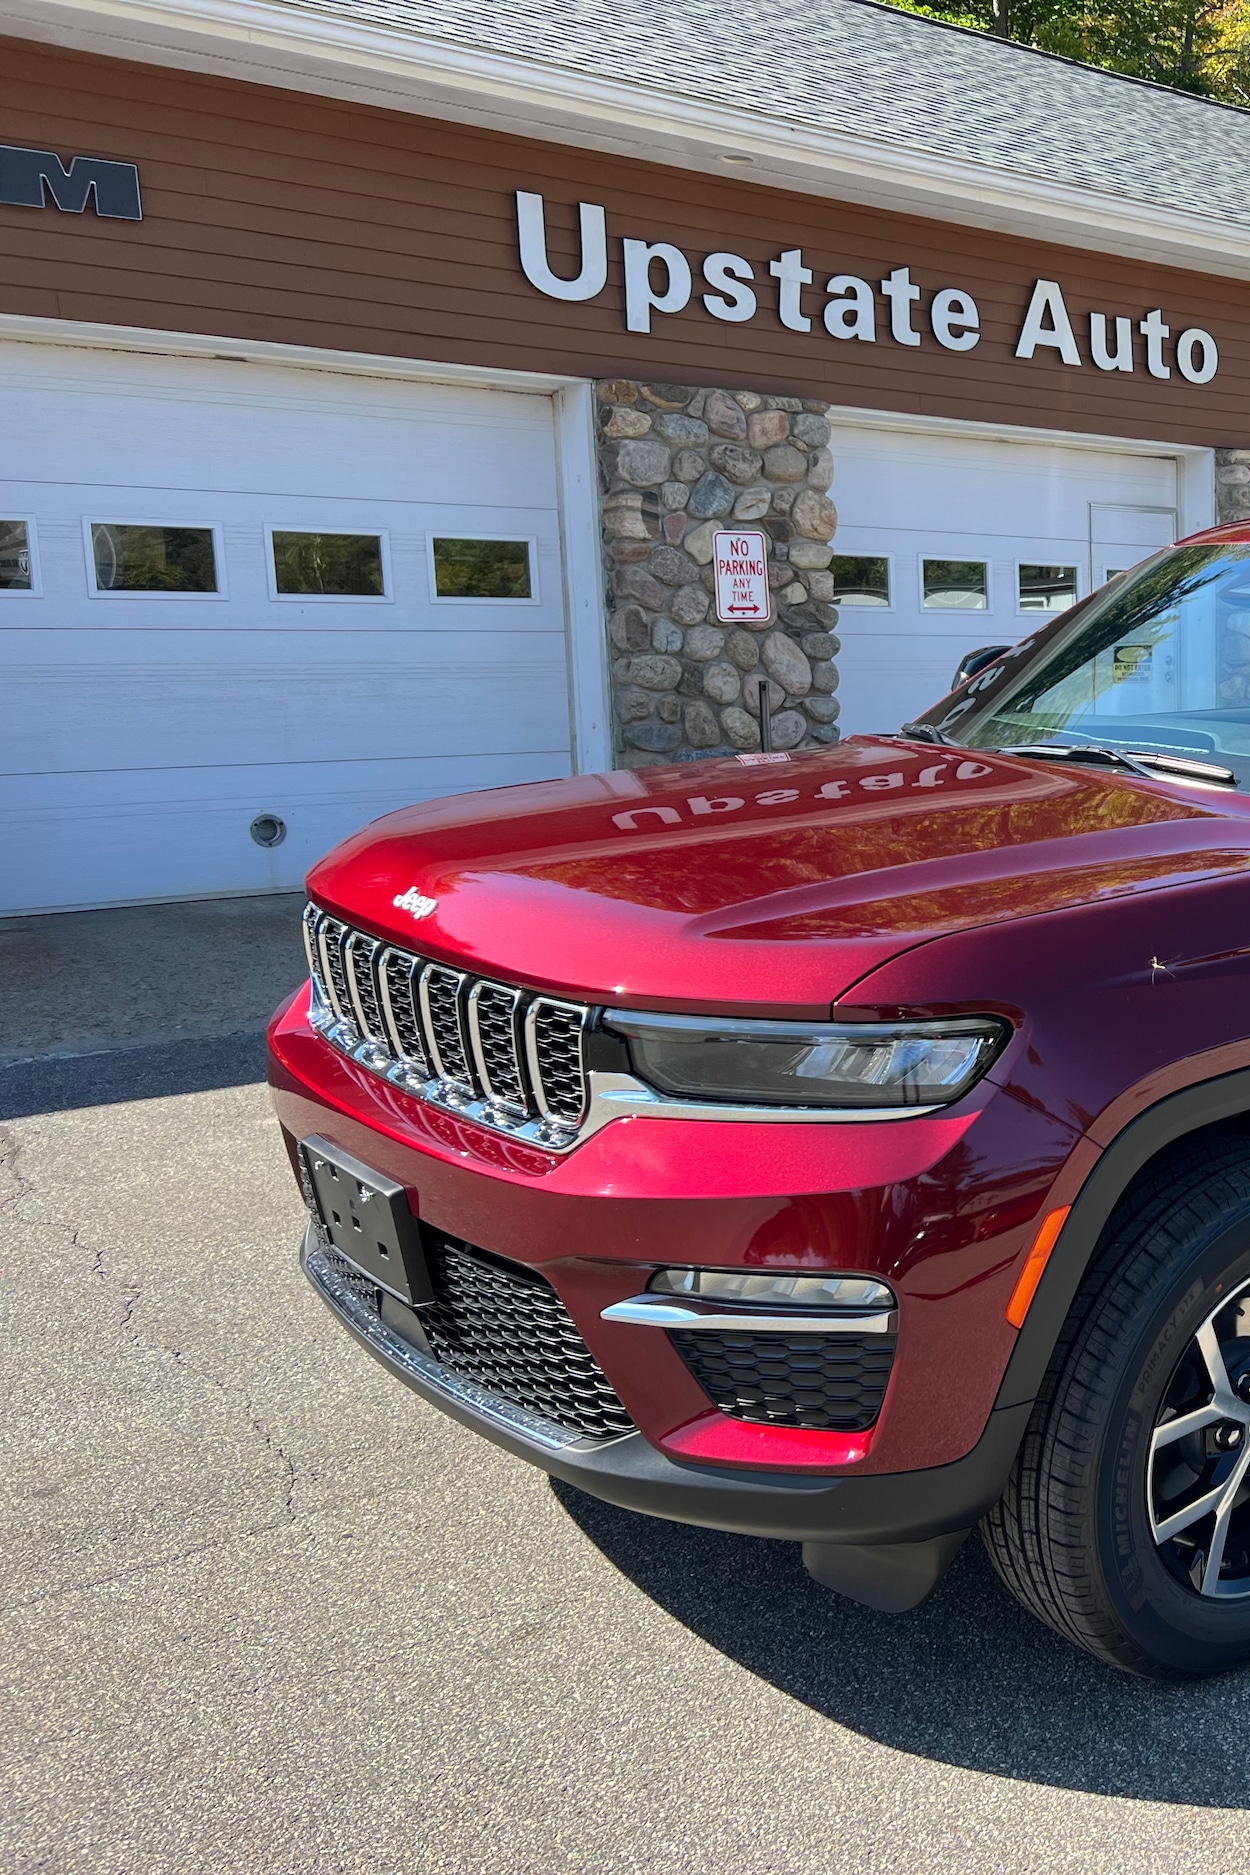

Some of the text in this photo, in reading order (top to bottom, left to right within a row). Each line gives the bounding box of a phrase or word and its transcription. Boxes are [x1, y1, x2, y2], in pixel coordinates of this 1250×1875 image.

[515, 190, 1220, 385] Upstate Auto
[730, 540, 749, 556] NO
[719, 559, 763, 576] PARKING
[732, 578, 752, 589] ANY
[731, 591, 754, 602] TIME
[392, 886, 438, 920] Jeep
[1138, 1290, 1196, 1395] PRIMACY LTX
[1114, 1416, 1140, 1557] MICHELIN
